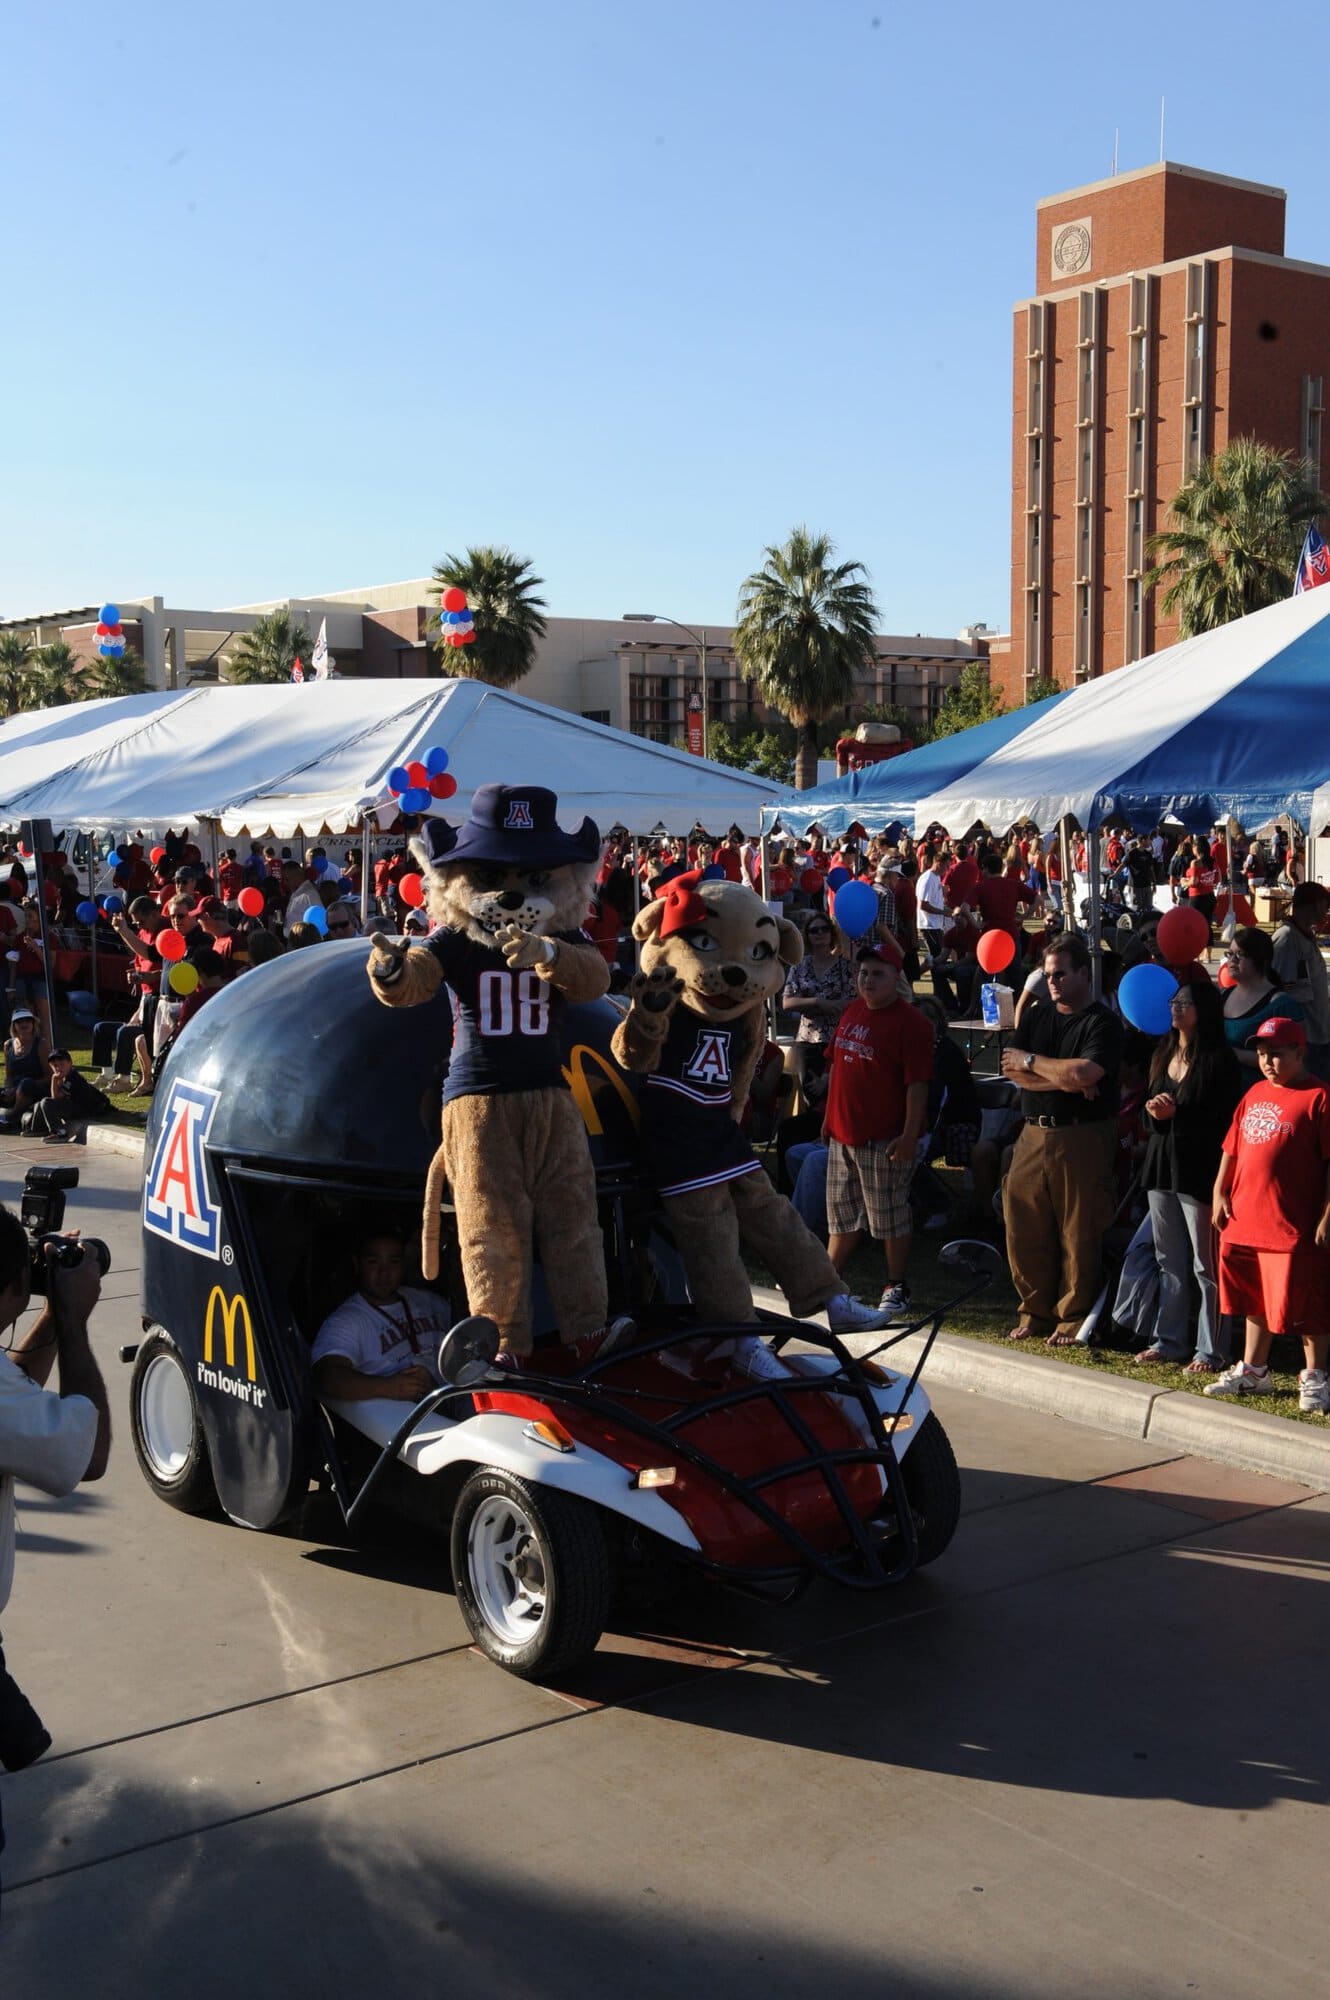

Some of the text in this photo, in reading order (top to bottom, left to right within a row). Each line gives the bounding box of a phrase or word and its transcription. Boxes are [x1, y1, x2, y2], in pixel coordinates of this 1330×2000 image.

[503, 800, 534, 829] A
[479, 970, 551, 1036] 08
[681, 1028, 732, 1087] A
[1247, 1101, 1283, 1117] ARIZONA
[144, 1077, 222, 1262] A
[218, 1369, 252, 1403] lovin'
